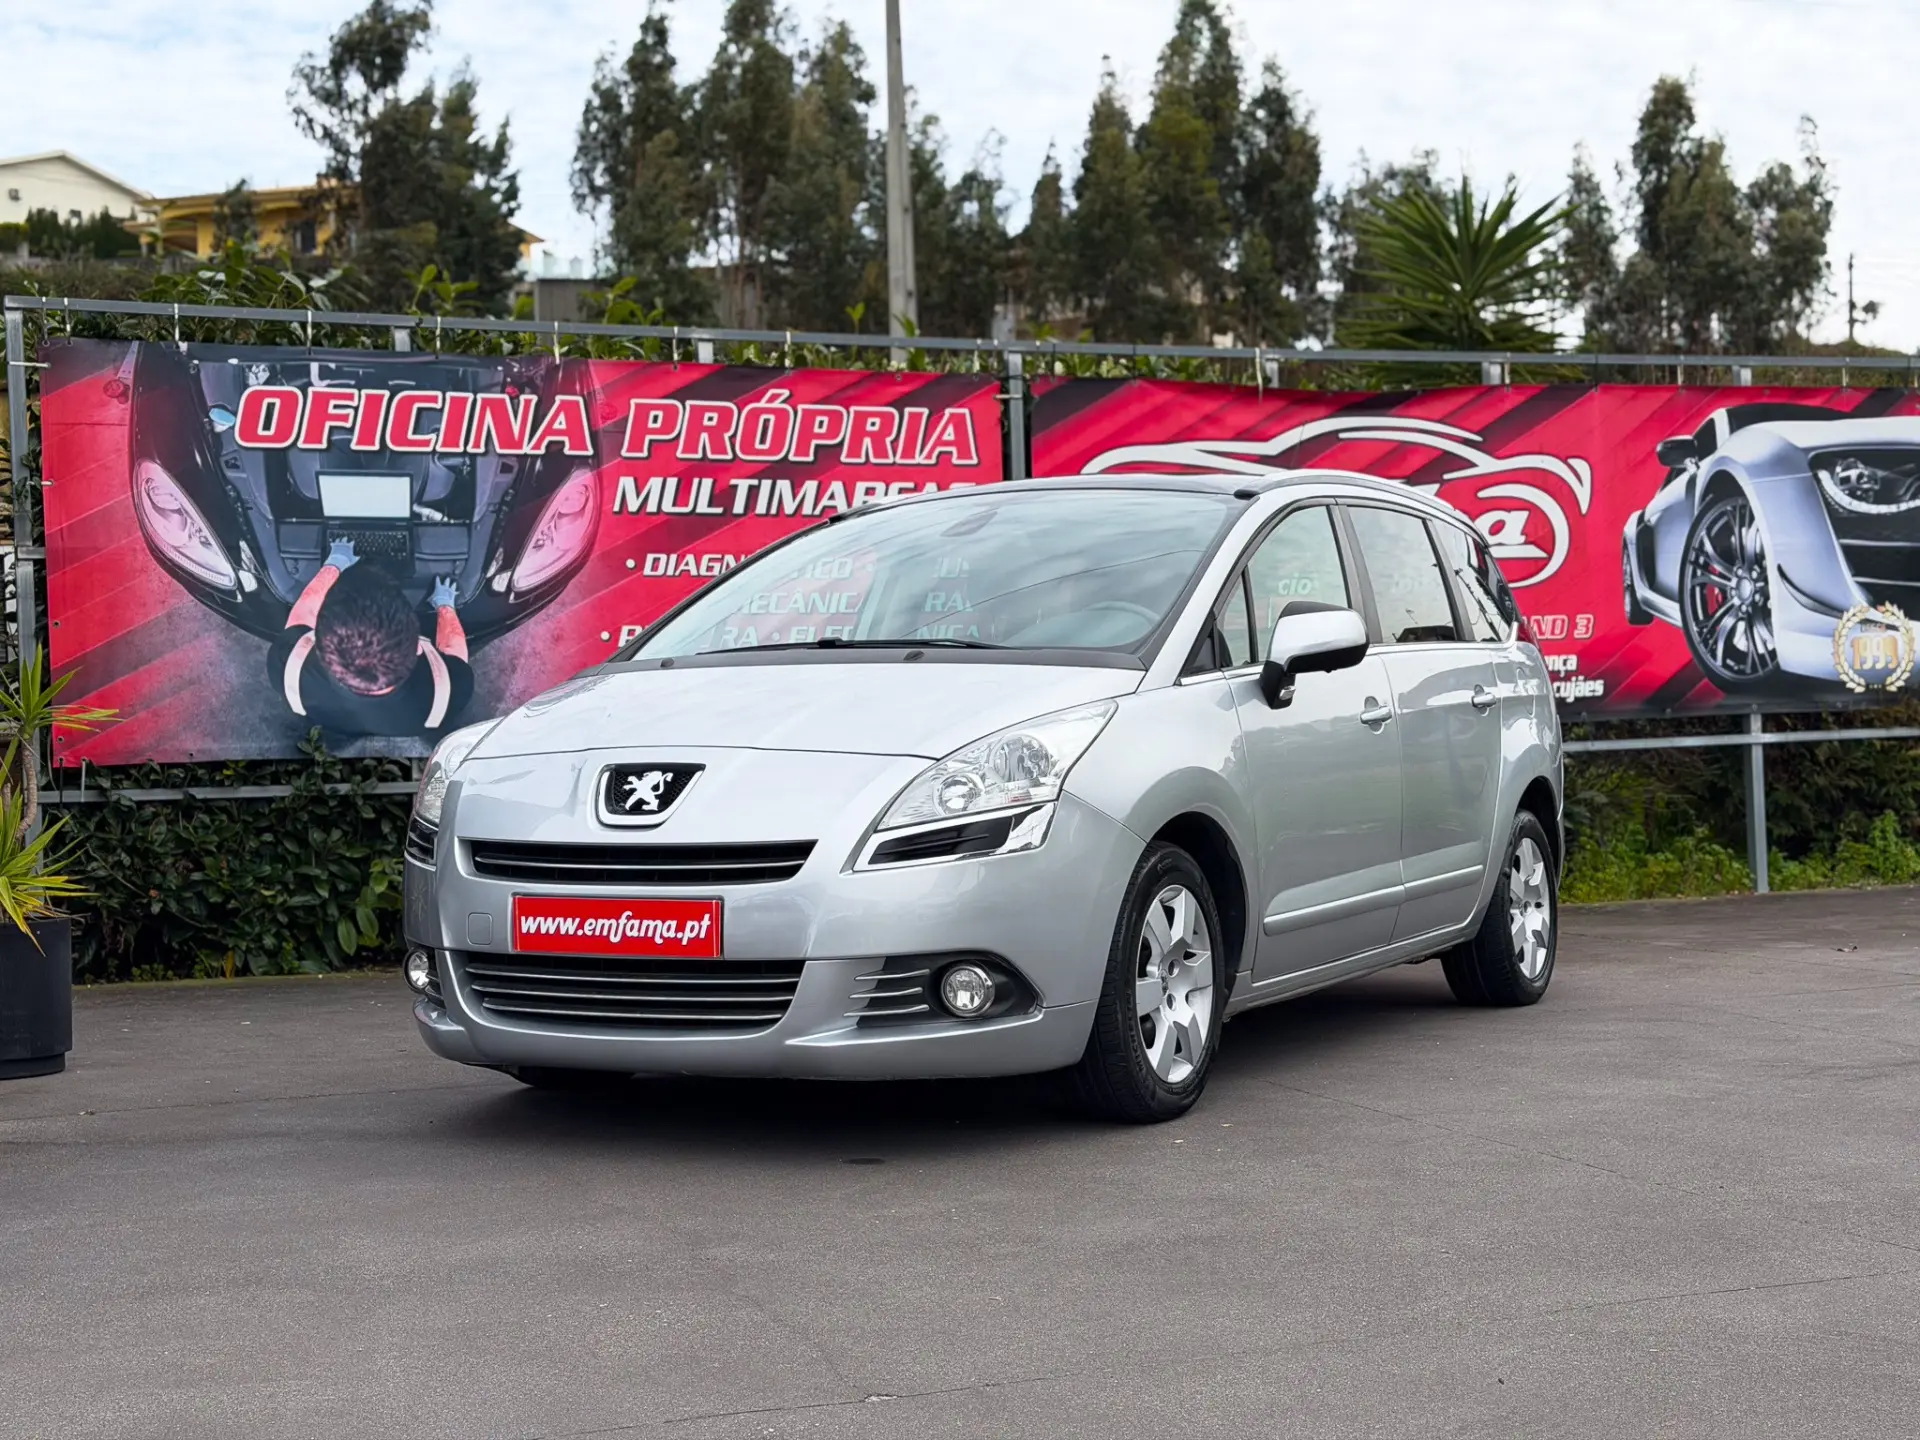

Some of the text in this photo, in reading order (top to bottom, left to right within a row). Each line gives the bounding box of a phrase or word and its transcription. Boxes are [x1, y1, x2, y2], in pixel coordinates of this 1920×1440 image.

[234, 385, 979, 464] OFICINA PRÓPRIA
[613, 476, 977, 517] MULTIMAR
[1552, 675, 1604, 703] cujães
[520, 910, 711, 945] www.emfama.pt
